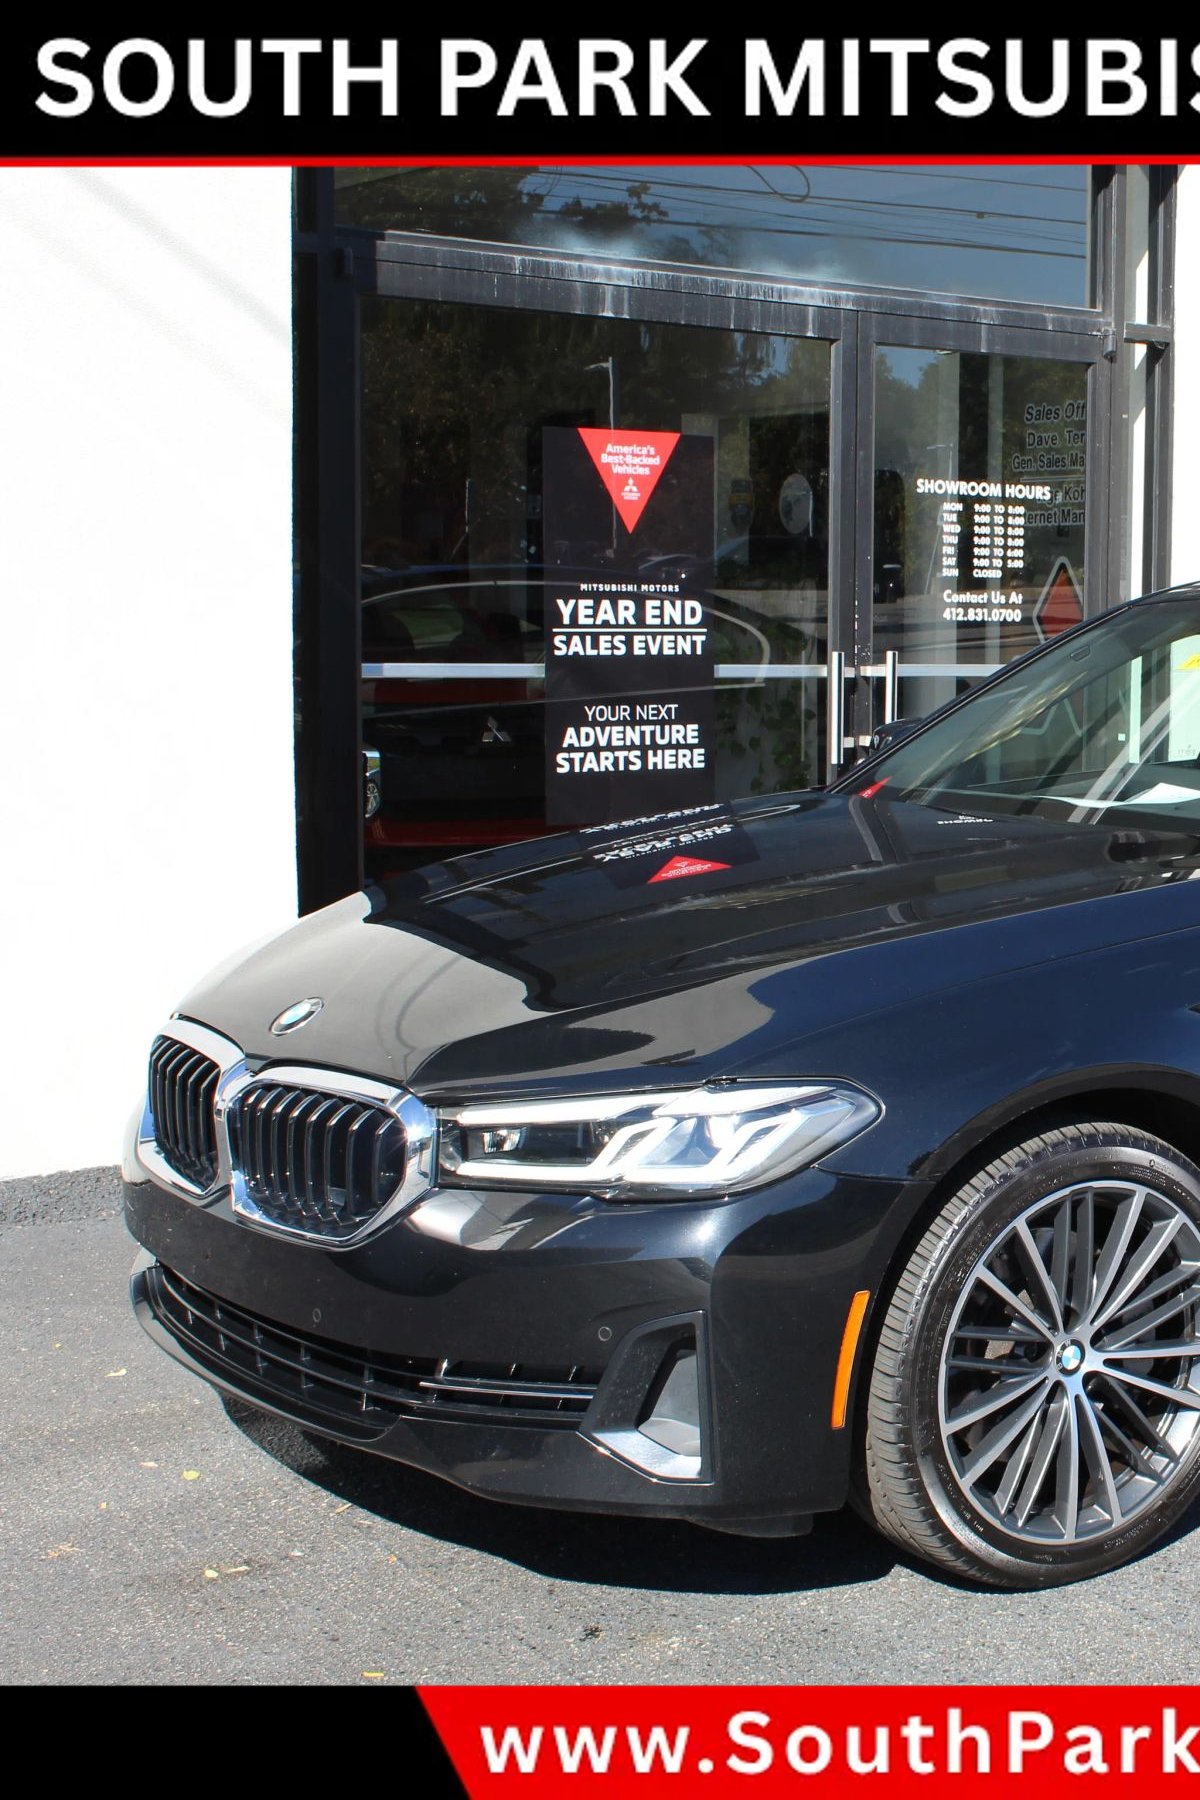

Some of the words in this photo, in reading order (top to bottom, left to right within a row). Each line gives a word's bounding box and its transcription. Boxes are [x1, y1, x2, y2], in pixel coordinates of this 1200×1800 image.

[1025, 404, 1060, 422] Sales
[1027, 432, 1058, 447] Dave
[606, 444, 655, 455] America's
[600, 453, 660, 466] Best-Backed
[1012, 455, 1036, 470] Gen.
[1038, 454, 1066, 469] Sales
[611, 465, 651, 475] Vehicles
[916, 479, 1002, 498] SHOWROOM
[1005, 484, 1051, 500] HOURS
[943, 502, 963, 512] MON
[974, 503, 991, 513] 9:00
[994, 505, 1005, 514] TO
[943, 513, 957, 522] TUE
[974, 514, 991, 524] 9:00
[993, 516, 1005, 524] TO
[943, 524, 961, 533] WED
[974, 525, 991, 534] 9:00
[994, 526, 1005, 535] TO
[943, 535, 958, 544] THU
[973, 536, 991, 545] 9:00
[993, 537, 1005, 546] TO
[942, 546, 955, 555] FRI
[973, 547, 990, 556] 9:00
[993, 548, 1004, 557] TO
[942, 557, 957, 566] SAT
[972, 558, 990, 567] 9:00
[992, 559, 1003, 568] TO
[942, 568, 959, 577] SUN
[973, 569, 1002, 578] CLOSED
[580, 583, 638, 592] MITSUBISHI
[641, 584, 680, 593] MOTORS
[943, 590, 987, 603] Contact
[991, 591, 1006, 604] Us
[1008, 592, 1023, 605] At
[556, 599, 637, 625] YEAR
[645, 599, 703, 625] END
[942, 607, 1022, 623] 412.831.0700
[553, 635, 627, 656] SALES
[633, 635, 706, 656] EVENT
[584, 705, 630, 722] YOUR
[636, 704, 678, 720] NEXT
[562, 724, 699, 748] ADVENTURE
[555, 750, 642, 774] STARTS
[647, 748, 706, 770] HERE
